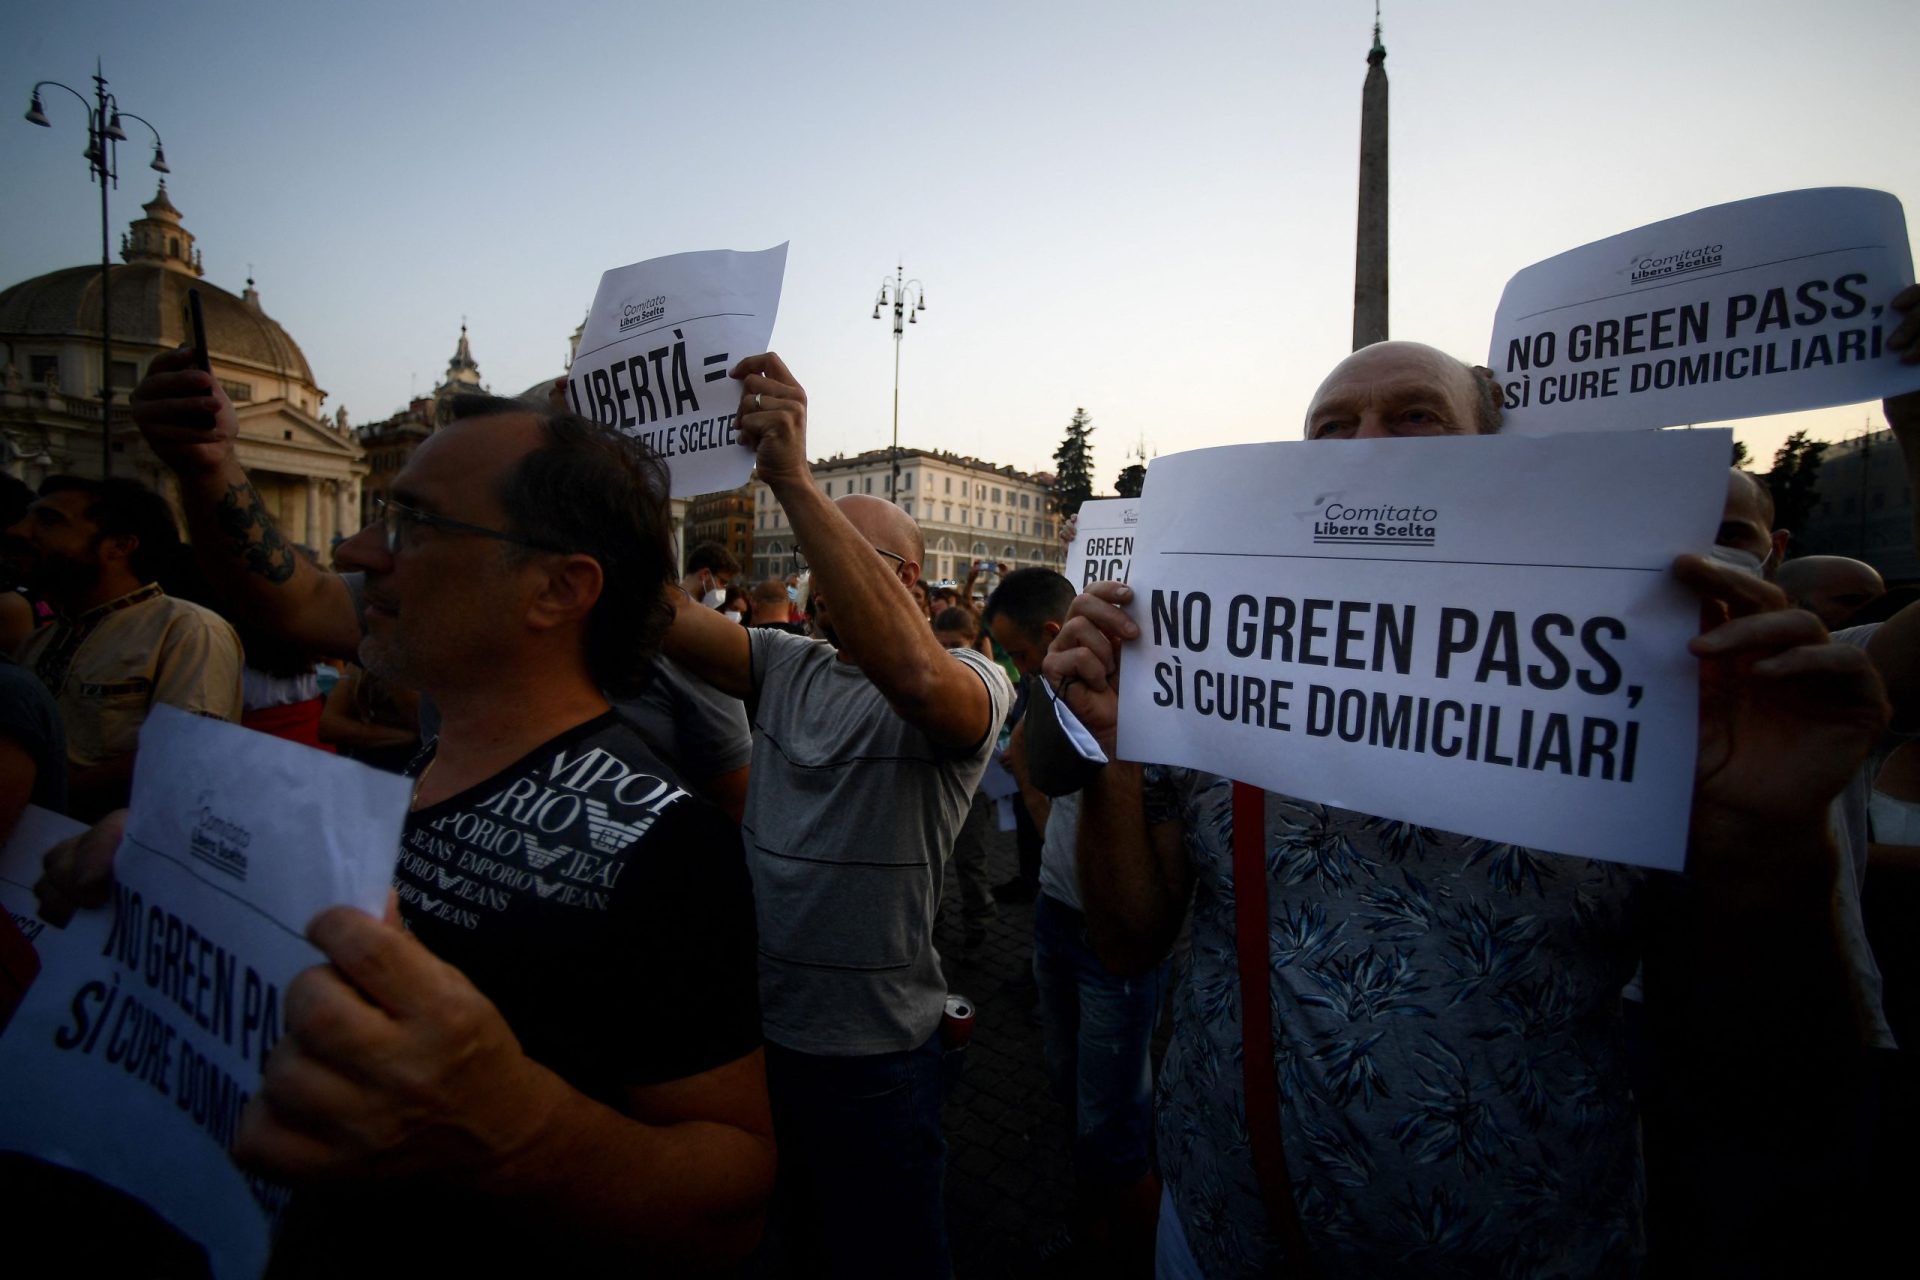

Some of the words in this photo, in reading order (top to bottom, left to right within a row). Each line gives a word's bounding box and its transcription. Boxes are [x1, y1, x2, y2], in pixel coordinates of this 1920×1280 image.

[1631, 266, 1672, 280] Libera
[1675, 254, 1722, 271] Scelta
[1639, 243, 1723, 270] Comitato
[620, 313, 641, 327] Libera
[642, 306, 665, 320] Scelta
[624, 295, 666, 317] Comitato
[1507, 330, 1555, 373] NO
[1568, 302, 1710, 362] GREEN
[1726, 273, 1884, 339] PASS,
[570, 328, 700, 428] LIBERTÀ
[1504, 366, 1530, 409] SÌ
[1539, 367, 1620, 405] CURE
[1630, 325, 1882, 394] DOMICILIARI
[679, 413, 738, 454] SCELTE
[1314, 521, 1370, 537] Libera
[1373, 522, 1436, 538] Scelta
[1325, 503, 1438, 523] Comitato
[1086, 537, 1134, 556] GREEN
[1151, 589, 1211, 652] NO
[1226, 593, 1416, 675] GREEN
[1435, 607, 1644, 709] PASS,
[1153, 656, 1183, 710] SÌ
[1194, 669, 1294, 733] CURE
[1306, 684, 1640, 784] DOMICILIARI
[410, 828, 456, 861] JEANS
[457, 850, 533, 890] EMPORIO
[454, 879, 512, 912] JEANS
[433, 902, 481, 930] JEANS
[103, 882, 143, 971] NO
[146, 905, 236, 1045] GREEN
[242, 967, 279, 1074] PA
[55, 971, 121, 1054] SÌ
[106, 994, 175, 1096] CURE
[177, 1036, 247, 1152] DOMI
